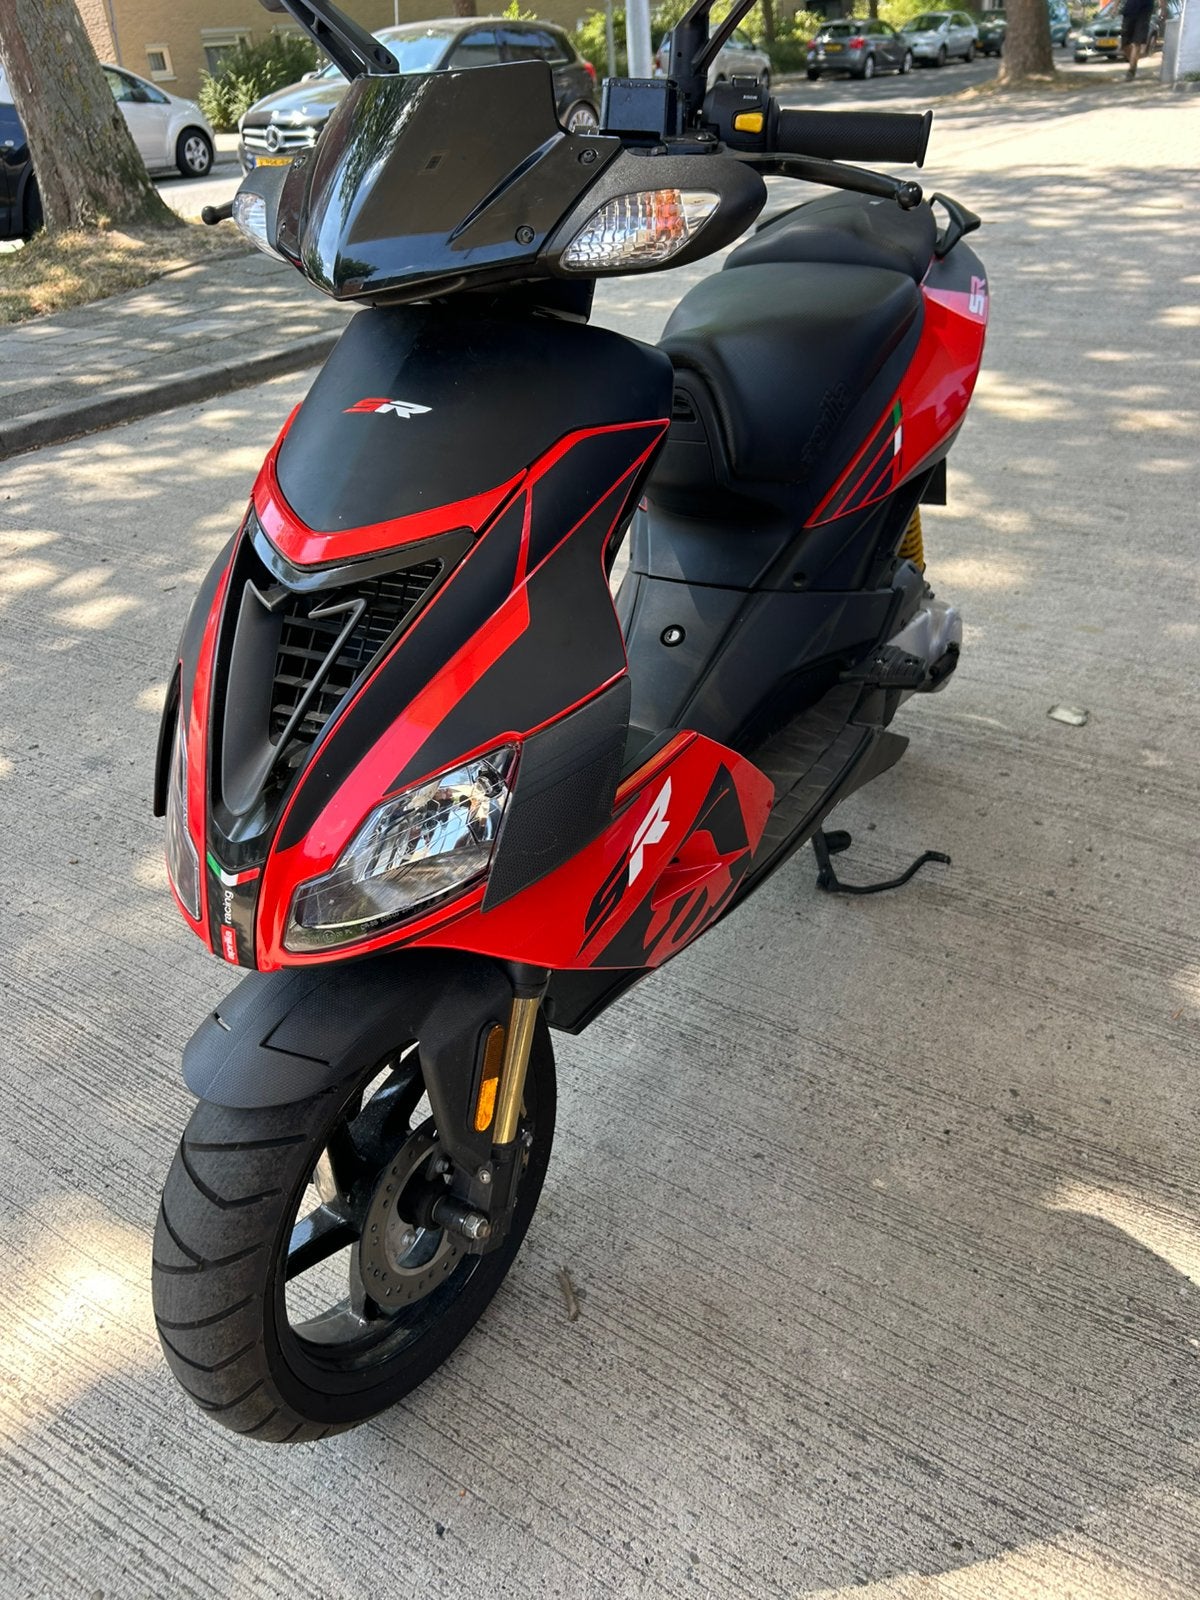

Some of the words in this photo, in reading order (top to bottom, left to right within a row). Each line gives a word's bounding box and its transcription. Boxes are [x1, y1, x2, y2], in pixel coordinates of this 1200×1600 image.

[969, 275, 985, 317] SR
[341, 397, 433, 419] SR
[576, 775, 672, 958] SR
[222, 890, 235, 925] racing
